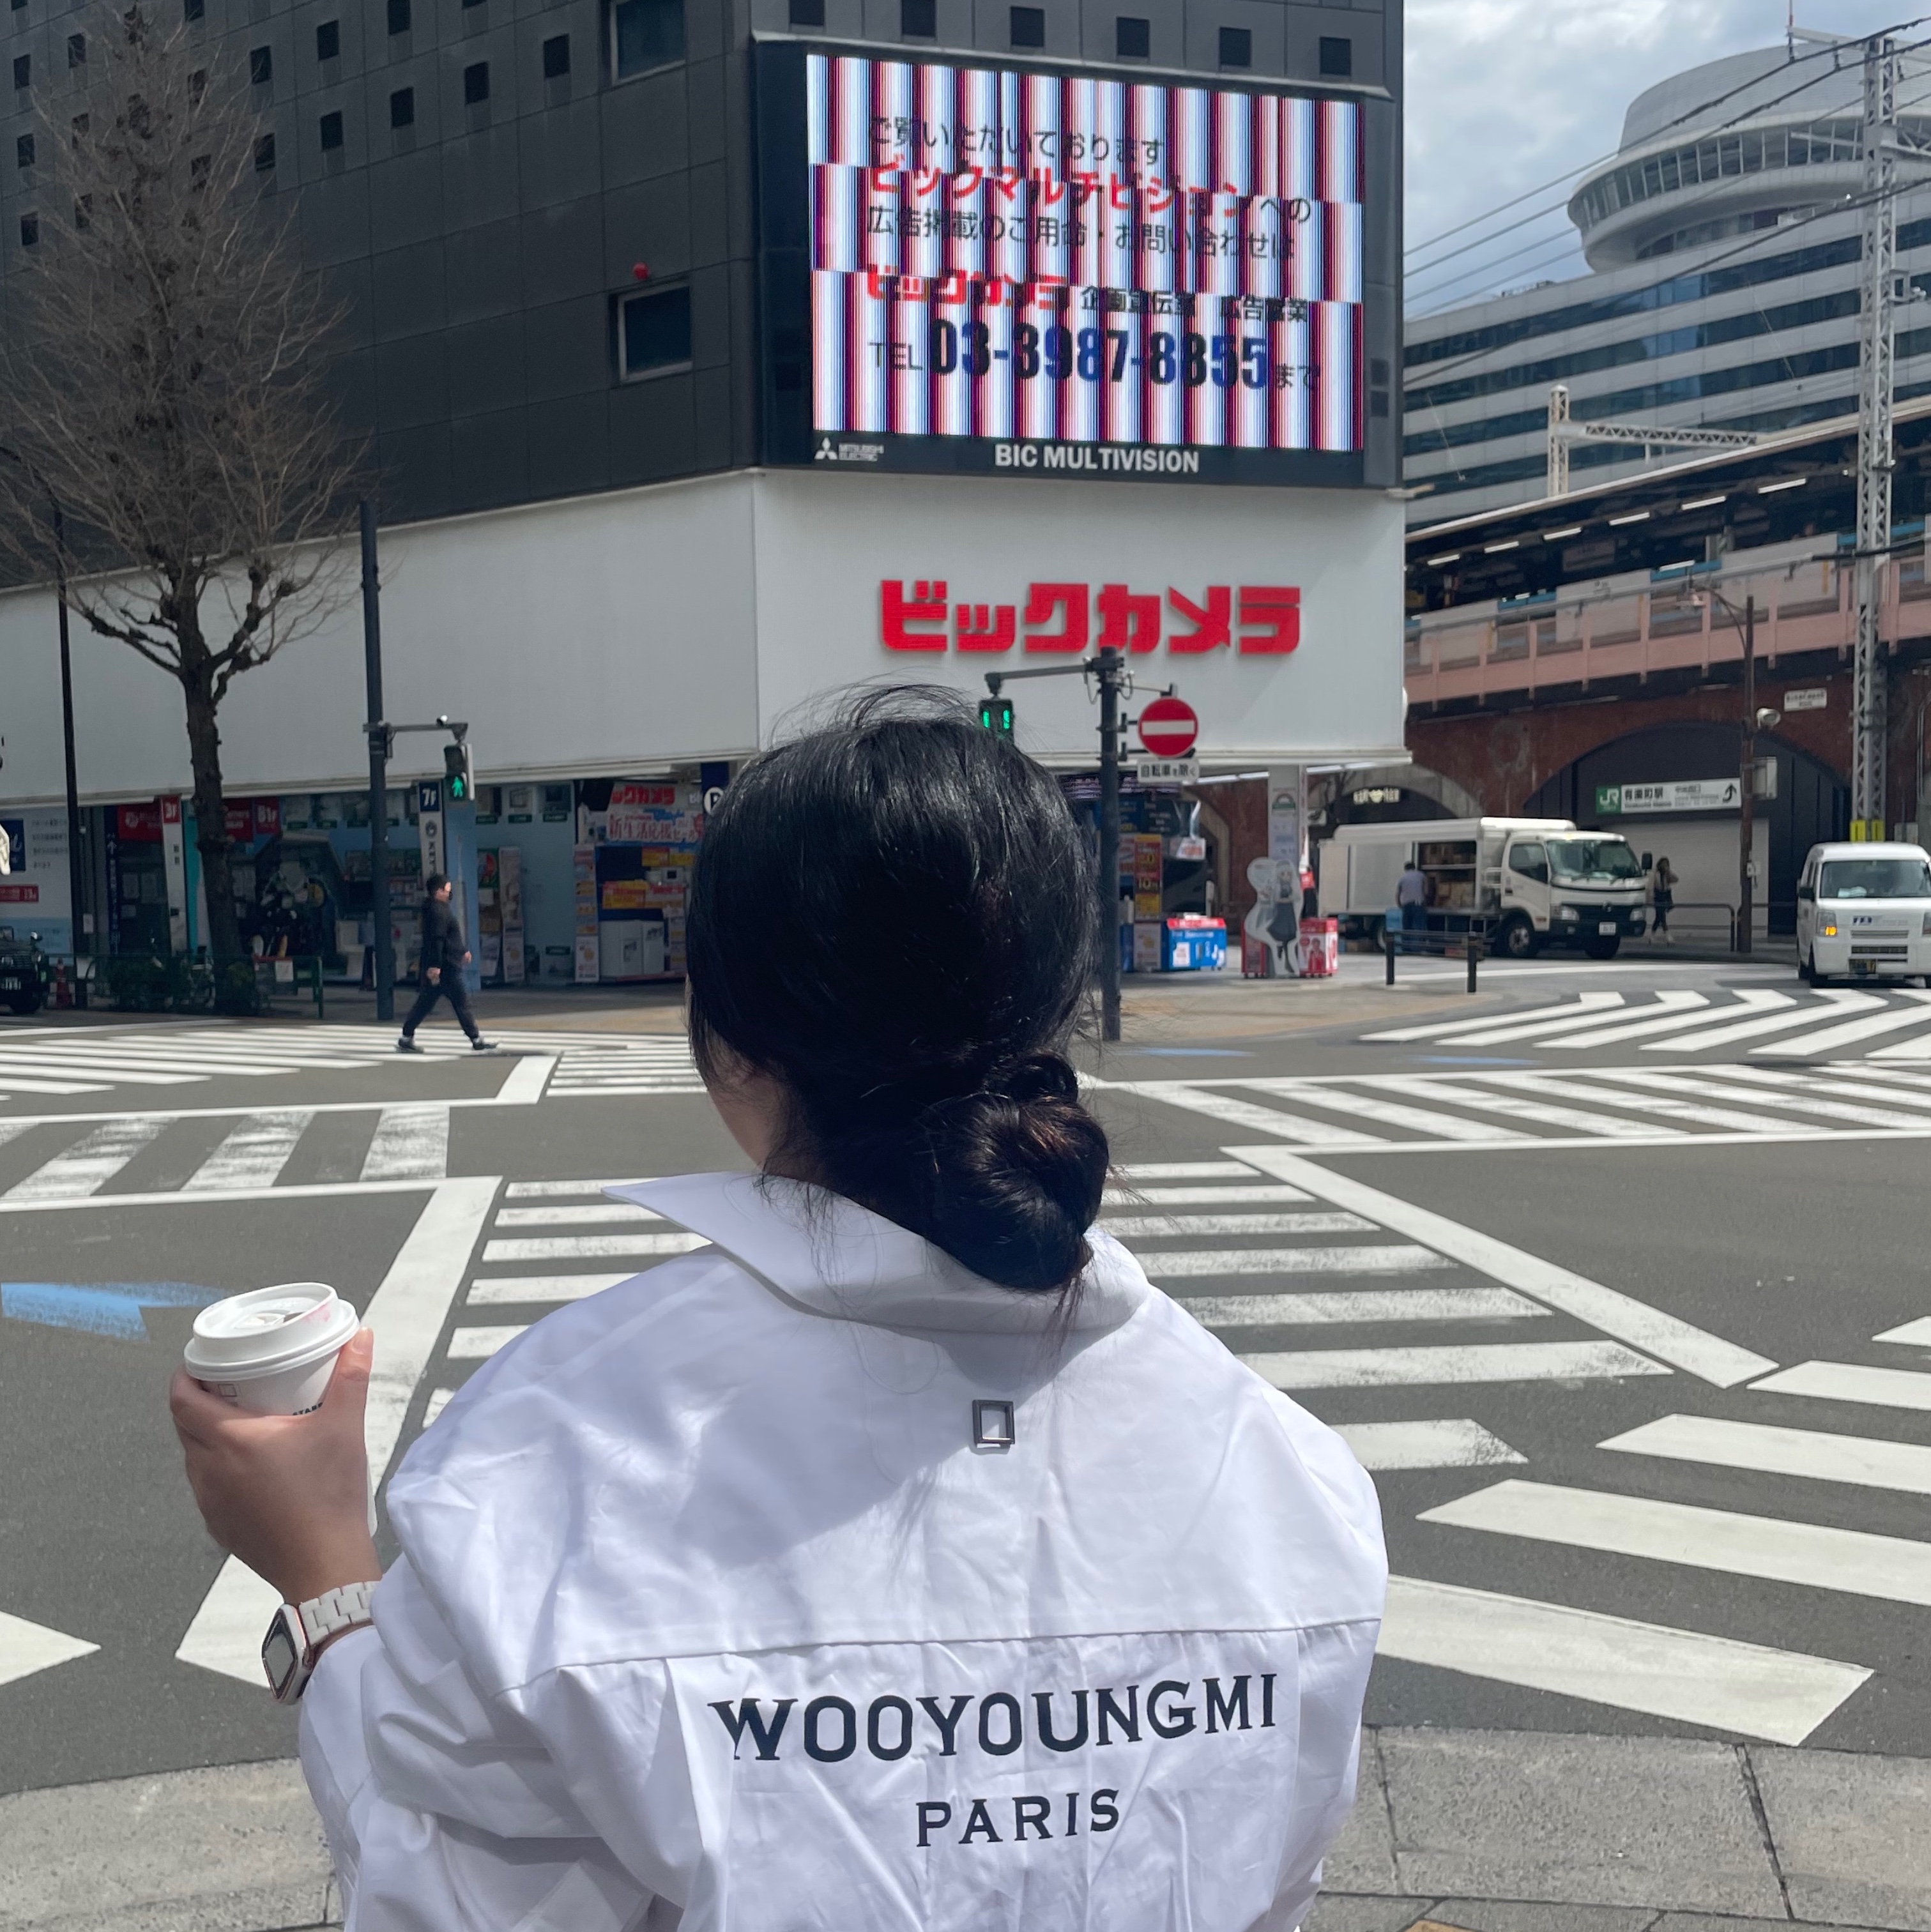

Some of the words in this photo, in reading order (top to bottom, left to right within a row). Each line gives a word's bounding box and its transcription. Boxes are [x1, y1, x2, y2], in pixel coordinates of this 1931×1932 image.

[868, 342, 922, 370] TEL
[929, 318, 1267, 390] 03-3987-8855
[995, 444, 1038, 467] BIC
[1043, 446, 1199, 473] MULTIVISION
[880, 579, 1301, 654] ビックカメラ
[1599, 788, 1619, 805] JR
[707, 1673, 1278, 1763] WOOYOUNGMI
[915, 1790, 1120, 1847] PARIS
